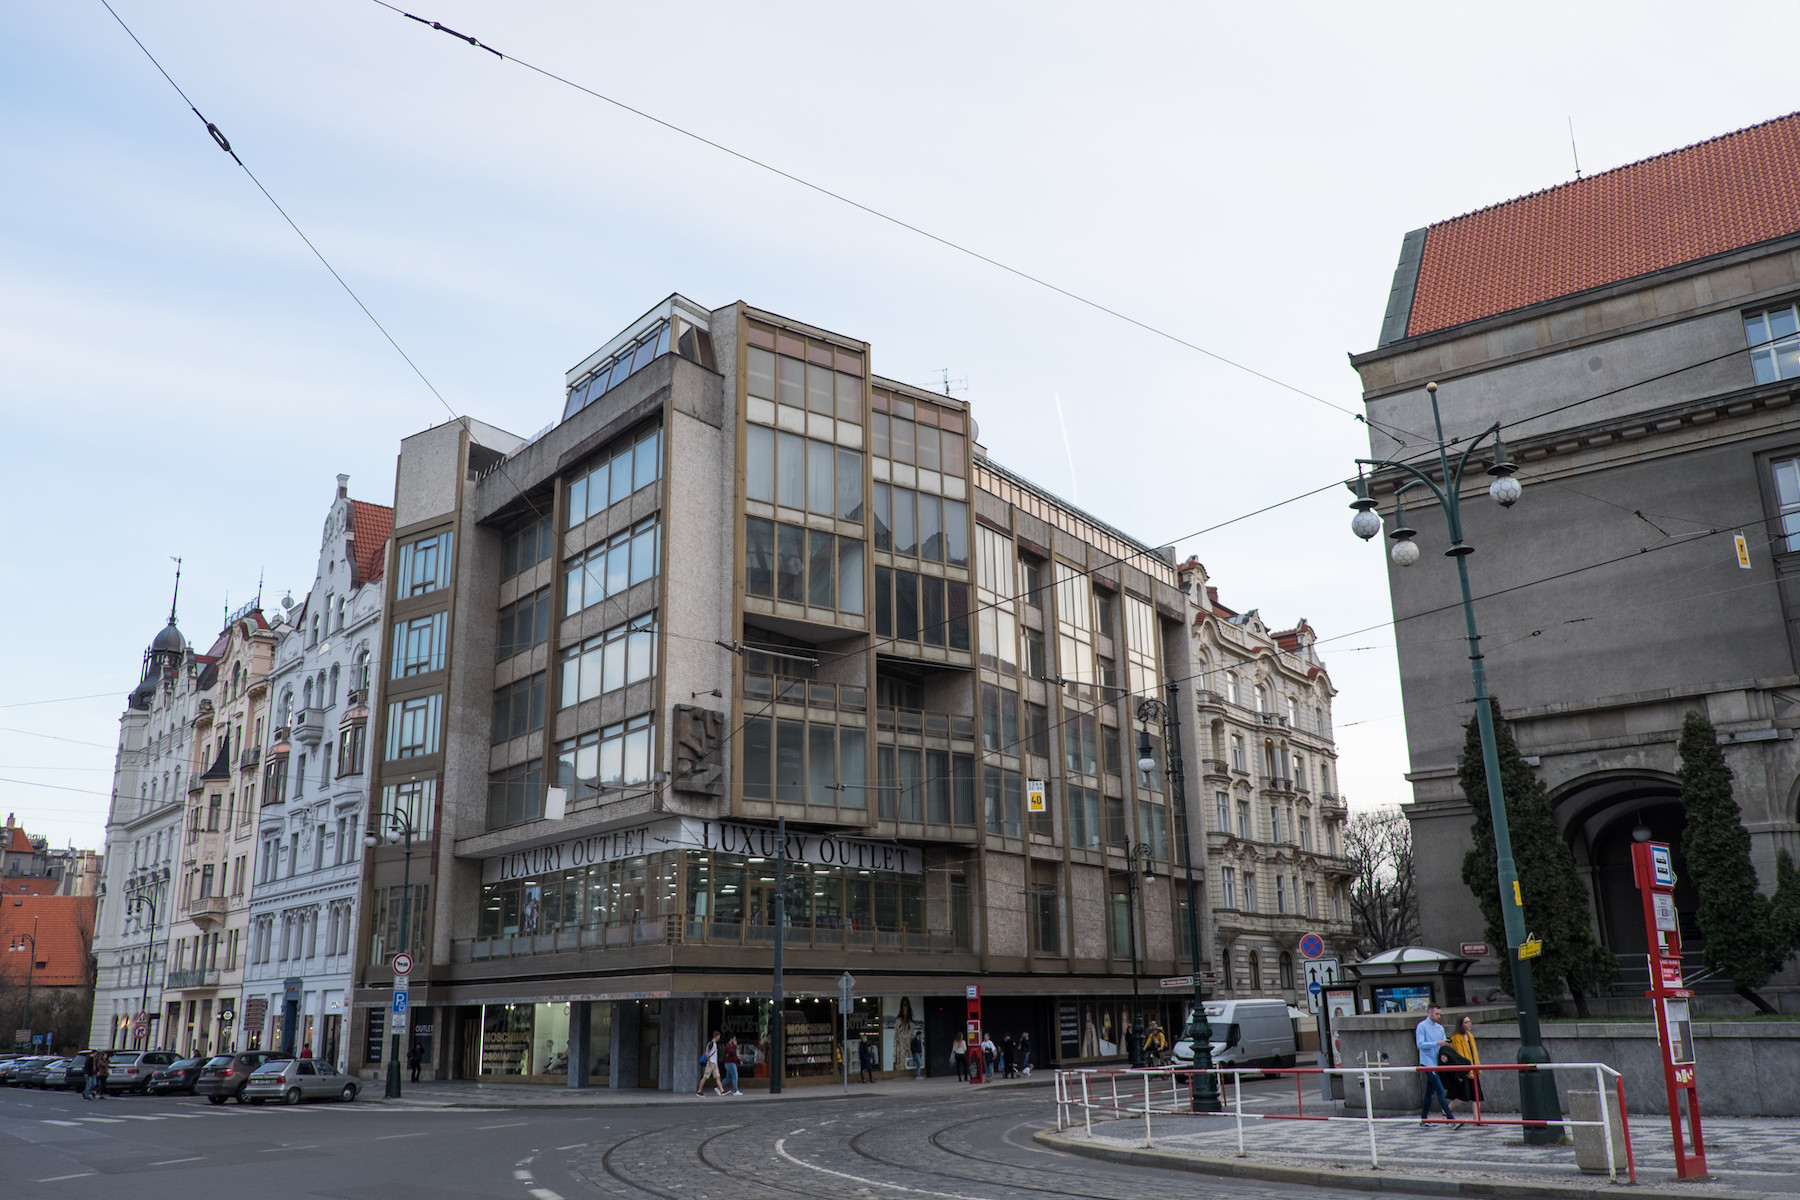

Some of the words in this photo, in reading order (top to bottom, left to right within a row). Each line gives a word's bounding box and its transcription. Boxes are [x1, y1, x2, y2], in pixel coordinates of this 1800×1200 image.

[1031, 796, 1042, 804] 40
[703, 822, 807, 861] LUXURY
[820, 838, 909, 871] OUTLET
[501, 843, 565, 881] LUXURY
[573, 828, 649, 866] OUTLET
[415, 1025, 433, 1033] OUTLET
[787, 1024, 832, 1035] MOSCHINO
[485, 1032, 529, 1043] MOSCHINO
